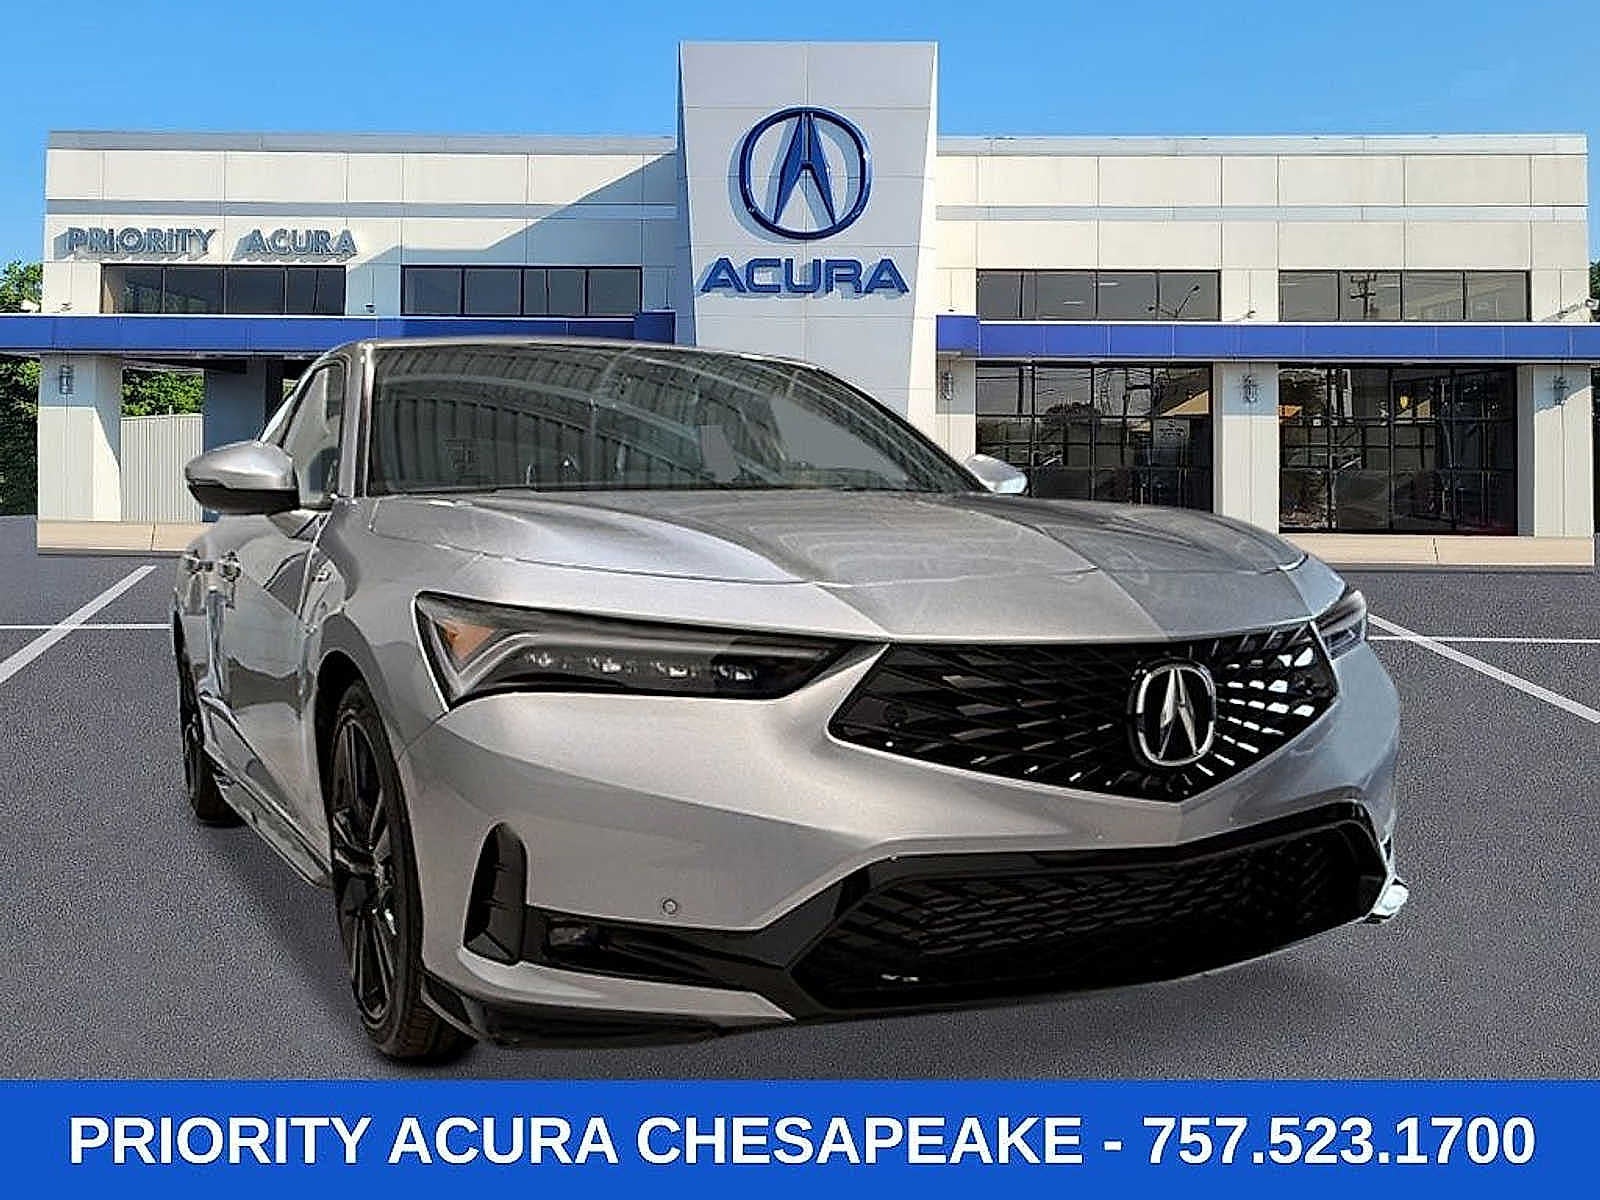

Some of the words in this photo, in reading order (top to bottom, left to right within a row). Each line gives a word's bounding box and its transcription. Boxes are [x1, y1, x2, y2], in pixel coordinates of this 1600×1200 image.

[66, 226, 215, 255] PRIORITY
[247, 227, 358, 256] ACURA
[700, 257, 910, 294] ACURA
